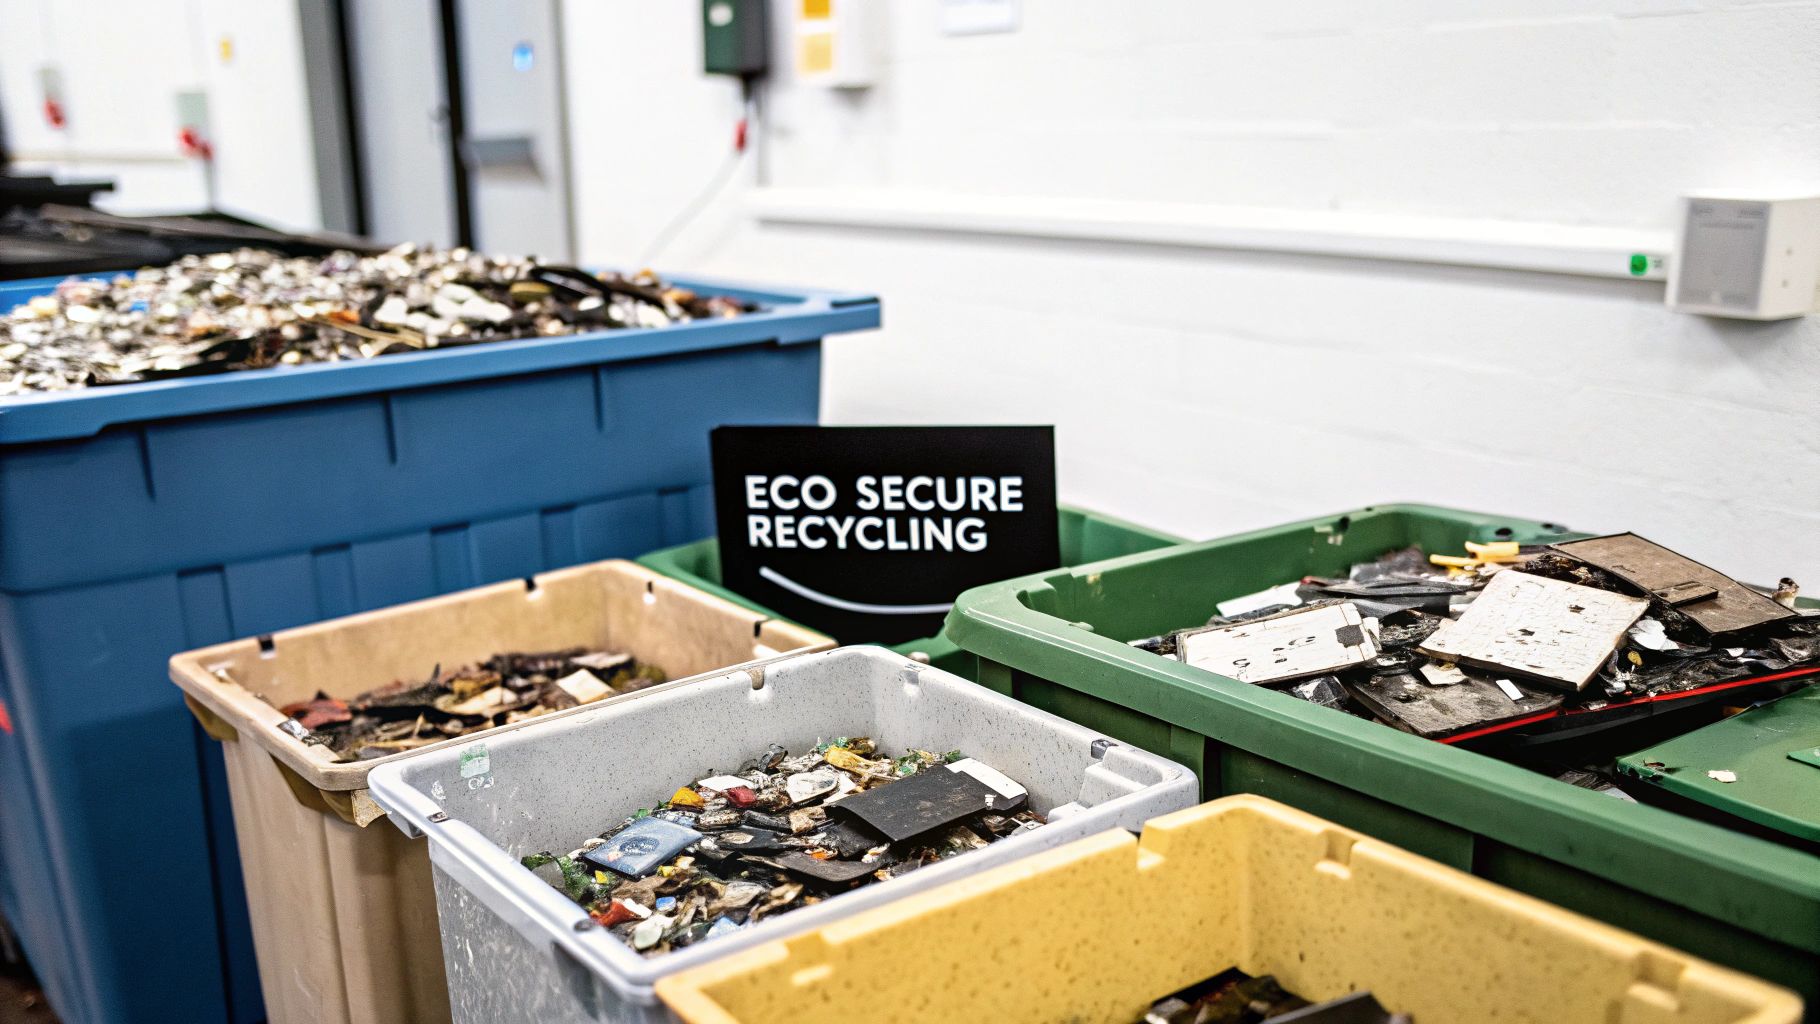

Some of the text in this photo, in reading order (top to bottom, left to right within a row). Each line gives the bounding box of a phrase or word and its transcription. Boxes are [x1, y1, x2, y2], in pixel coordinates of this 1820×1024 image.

[745, 475, 1024, 512] ECO SECURE
[747, 514, 988, 552] RECYCLING
